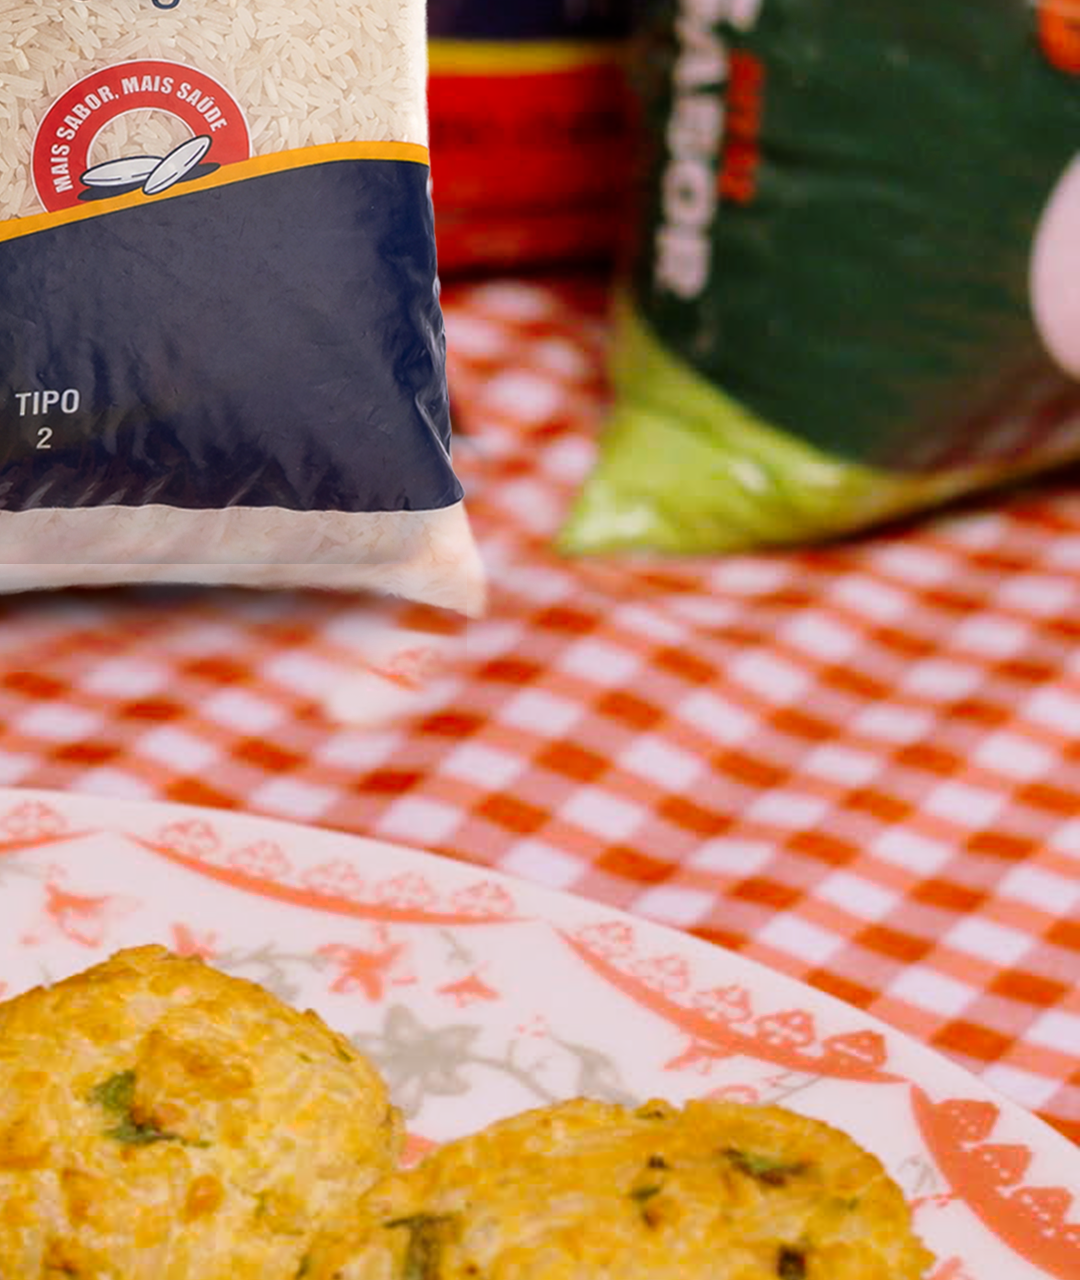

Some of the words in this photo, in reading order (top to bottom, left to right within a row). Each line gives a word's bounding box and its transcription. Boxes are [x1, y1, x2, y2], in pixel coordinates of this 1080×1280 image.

[121, 75, 175, 96] MAIS
[55, 84, 120, 141] SABOR,
[176, 82, 228, 133] SAÚDE
[51, 143, 74, 194] MAIS
[14, 387, 81, 417] TIPO
[35, 426, 53, 450] 2
